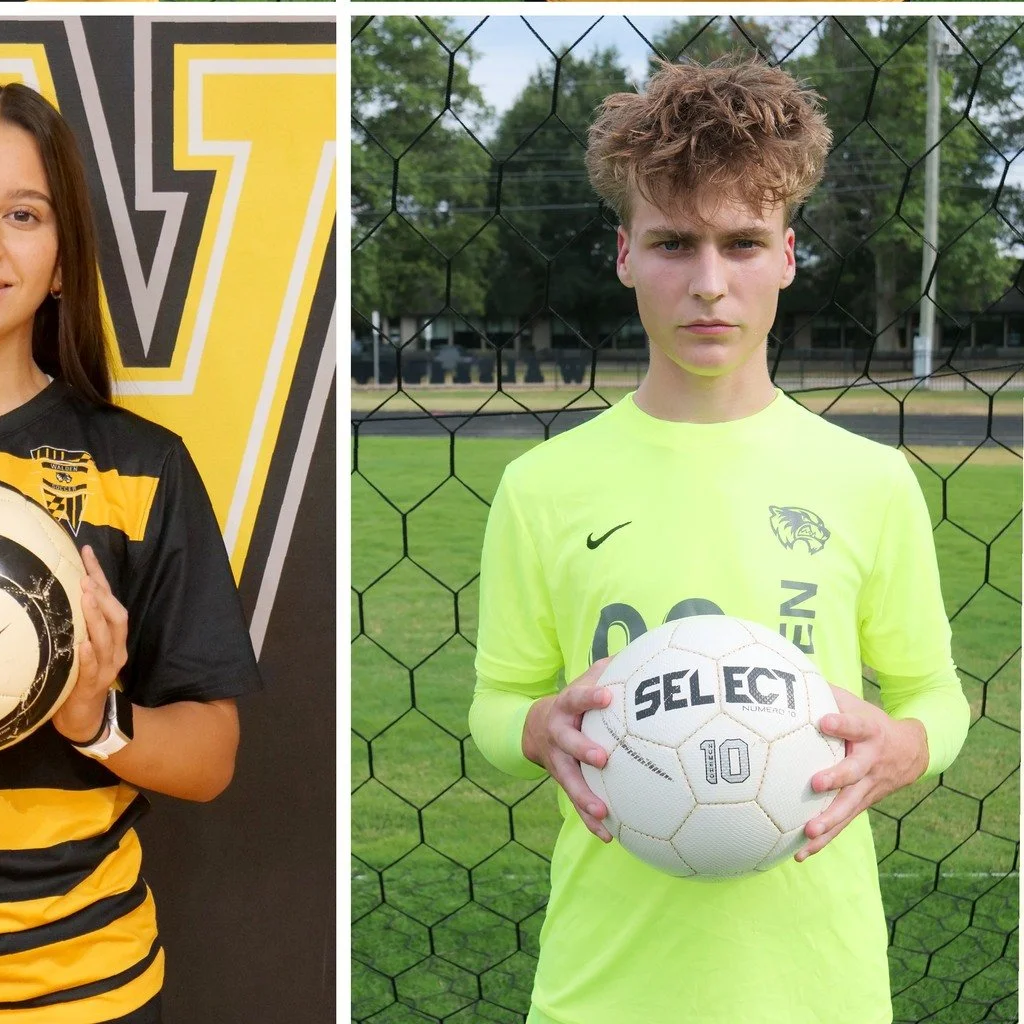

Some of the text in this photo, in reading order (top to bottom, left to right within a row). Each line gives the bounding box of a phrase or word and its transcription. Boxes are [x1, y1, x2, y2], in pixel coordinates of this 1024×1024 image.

[51, 463, 78, 472] WALDEN
[634, 665, 797, 721] SELECT
[742, 705, 785, 715] NUMERO
[699, 738, 751, 785] 10
